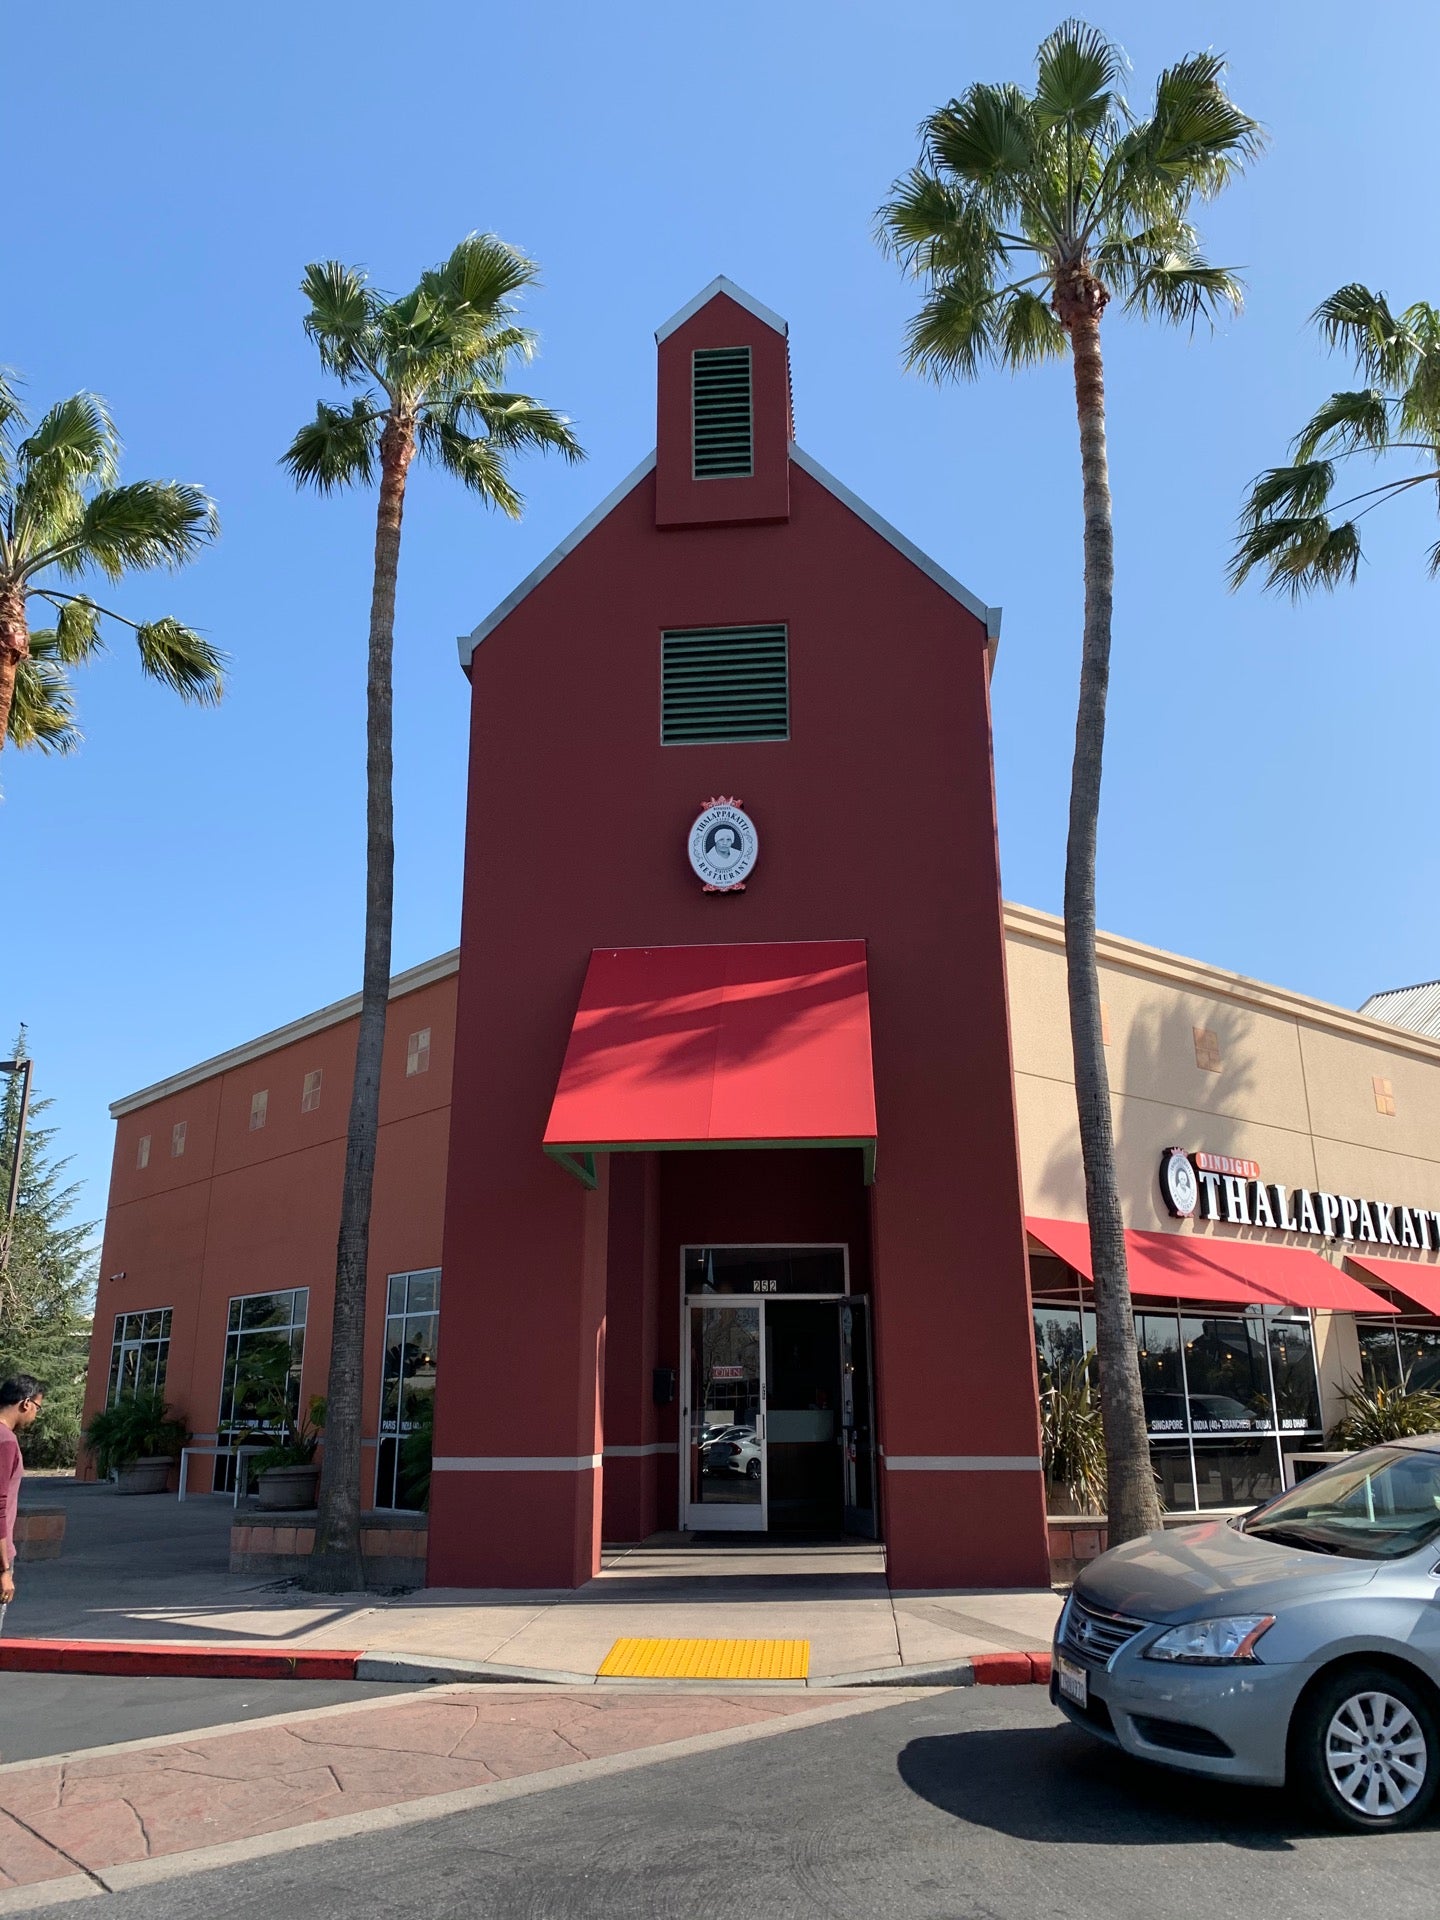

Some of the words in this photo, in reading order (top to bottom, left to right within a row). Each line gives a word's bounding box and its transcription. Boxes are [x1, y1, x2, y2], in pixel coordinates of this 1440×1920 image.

[696, 811, 749, 832] THALAPPAKATTI
[698, 860, 748, 880] RESTAURANT
[1199, 1152, 1257, 1177] DINDIGUL
[753, 1280, 777, 1292] 252
[715, 1368, 740, 1377] OPEN
[383, 1421, 396, 1430] PARIS
[1151, 1420, 1183, 1430] SINGAPORE
[1193, 1420, 1209, 1430] INDIA
[1282, 1419, 1293, 1429] ABU
